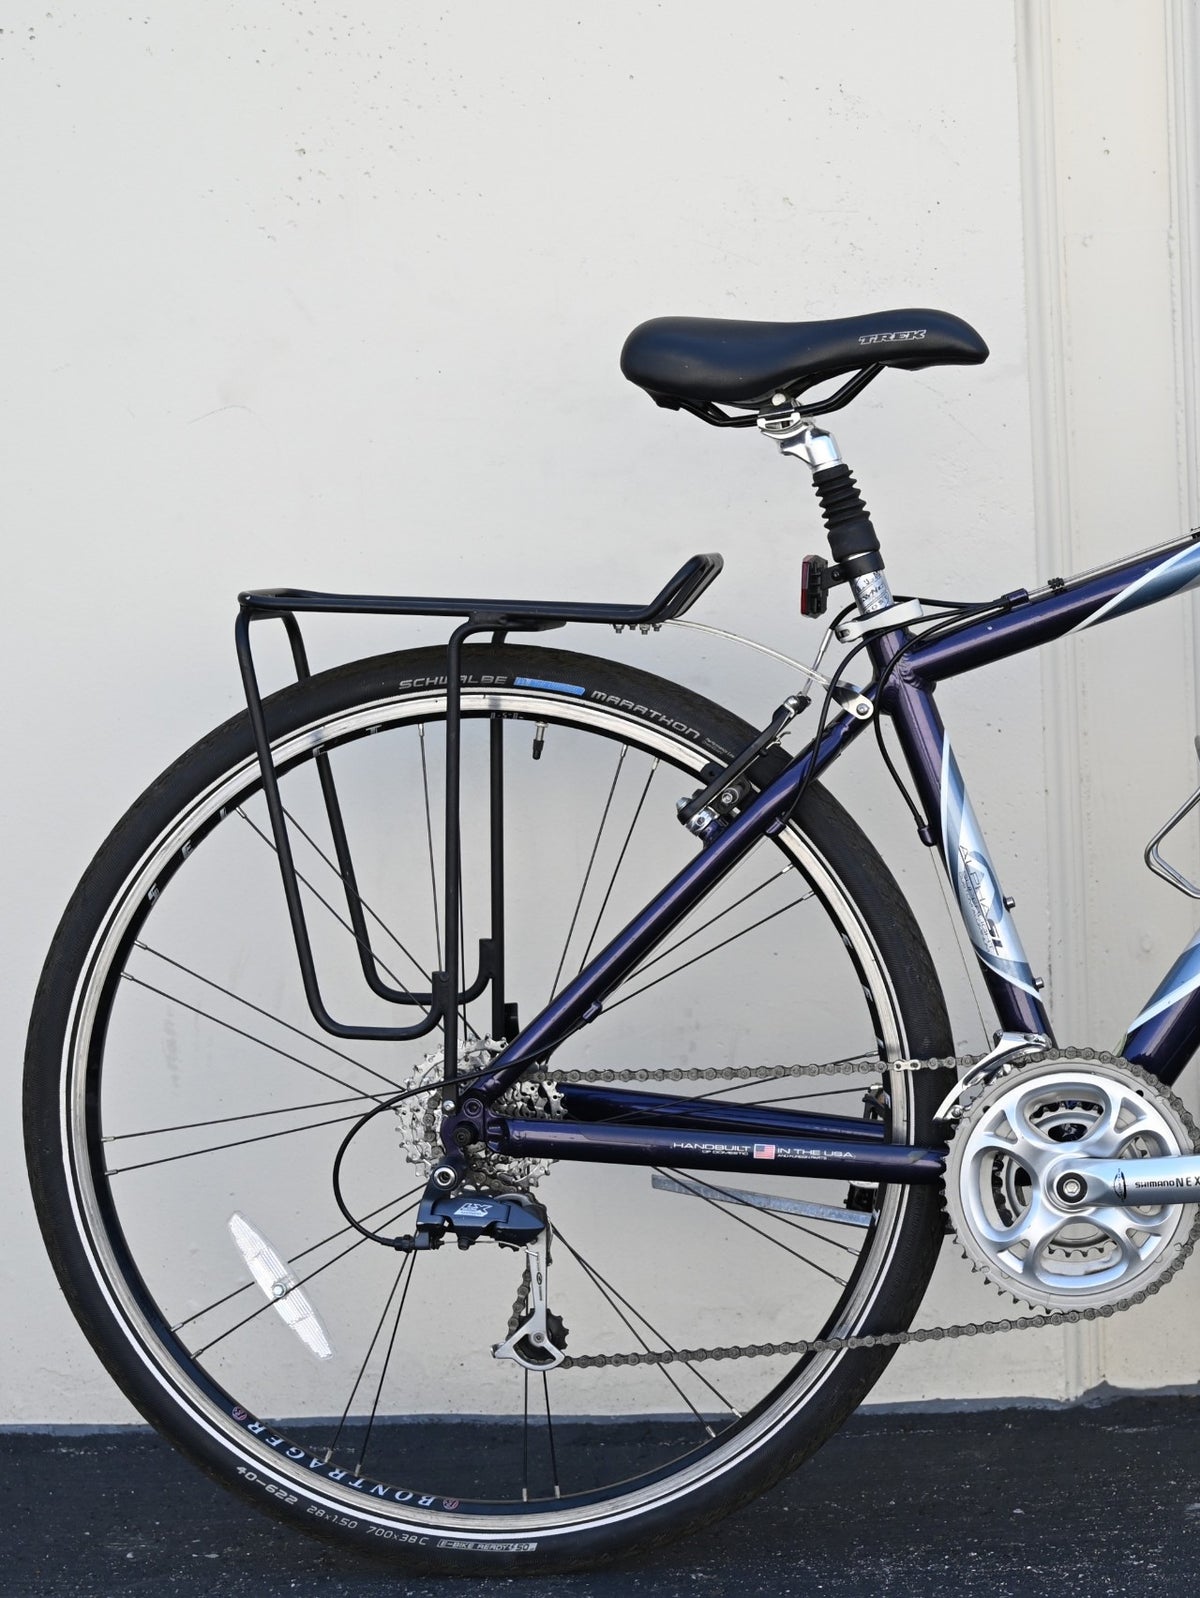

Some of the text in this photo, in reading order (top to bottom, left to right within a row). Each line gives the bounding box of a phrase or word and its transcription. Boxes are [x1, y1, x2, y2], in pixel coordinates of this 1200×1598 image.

[857, 328, 927, 346] TREK
[590, 690, 701, 740] MARATHON
[673, 1142, 751, 1152] HANDBUILT
[793, 1148, 821, 1156] THE
[823, 1150, 853, 1158] USA
[1134, 1179, 1175, 1189] SHIMANO
[247, 1421, 437, 1508] BONTRAGER
[236, 1465, 299, 1506] 40-622
[306, 1504, 358, 1530] 28x1.50
